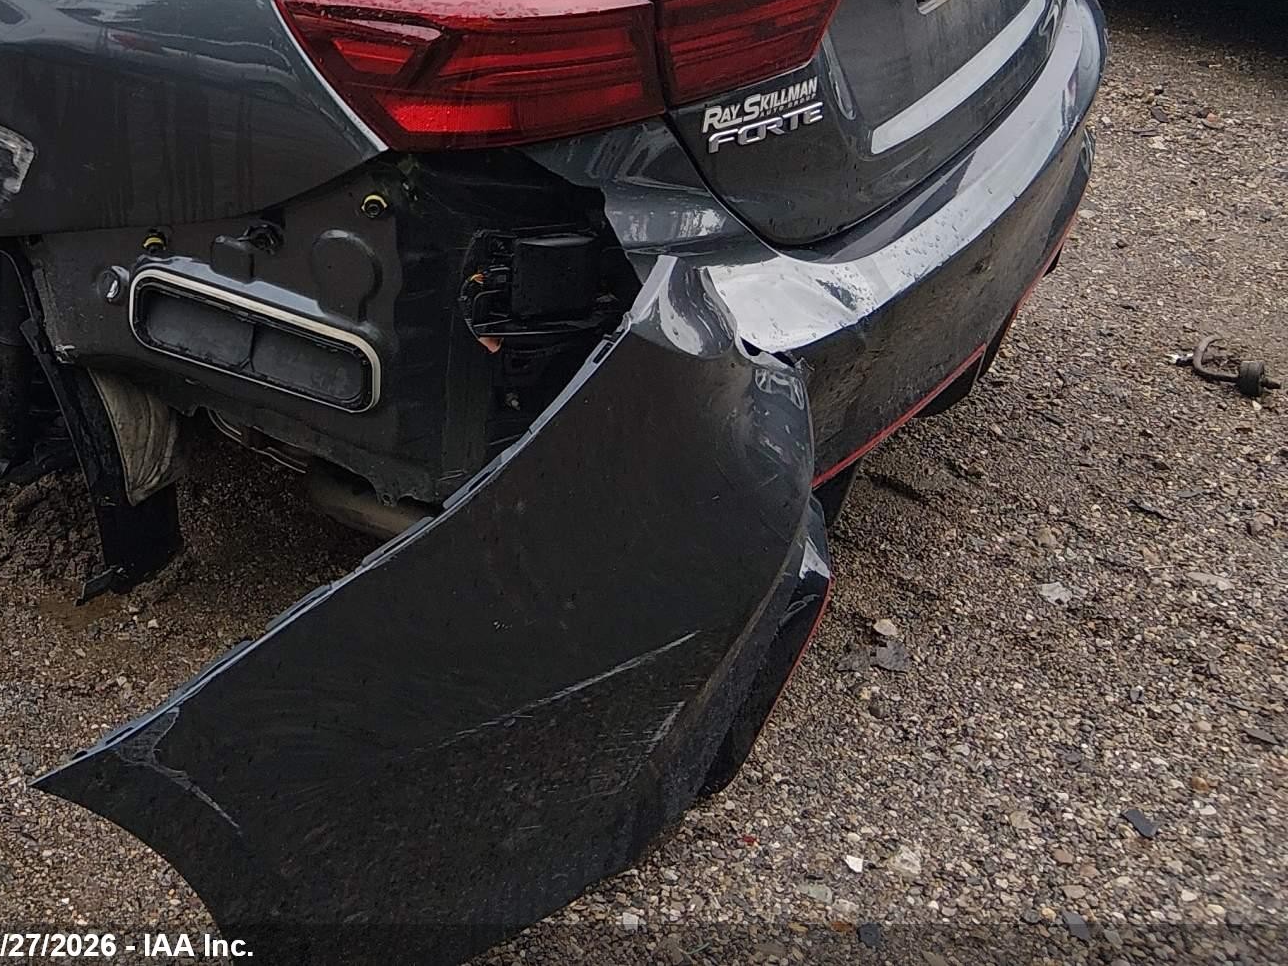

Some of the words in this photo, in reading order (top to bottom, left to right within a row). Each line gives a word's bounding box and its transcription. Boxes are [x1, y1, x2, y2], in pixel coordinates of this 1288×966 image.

[701, 103, 743, 133] RAY
[743, 76, 818, 122] SKILLMAN
[708, 101, 823, 154] FORTE
